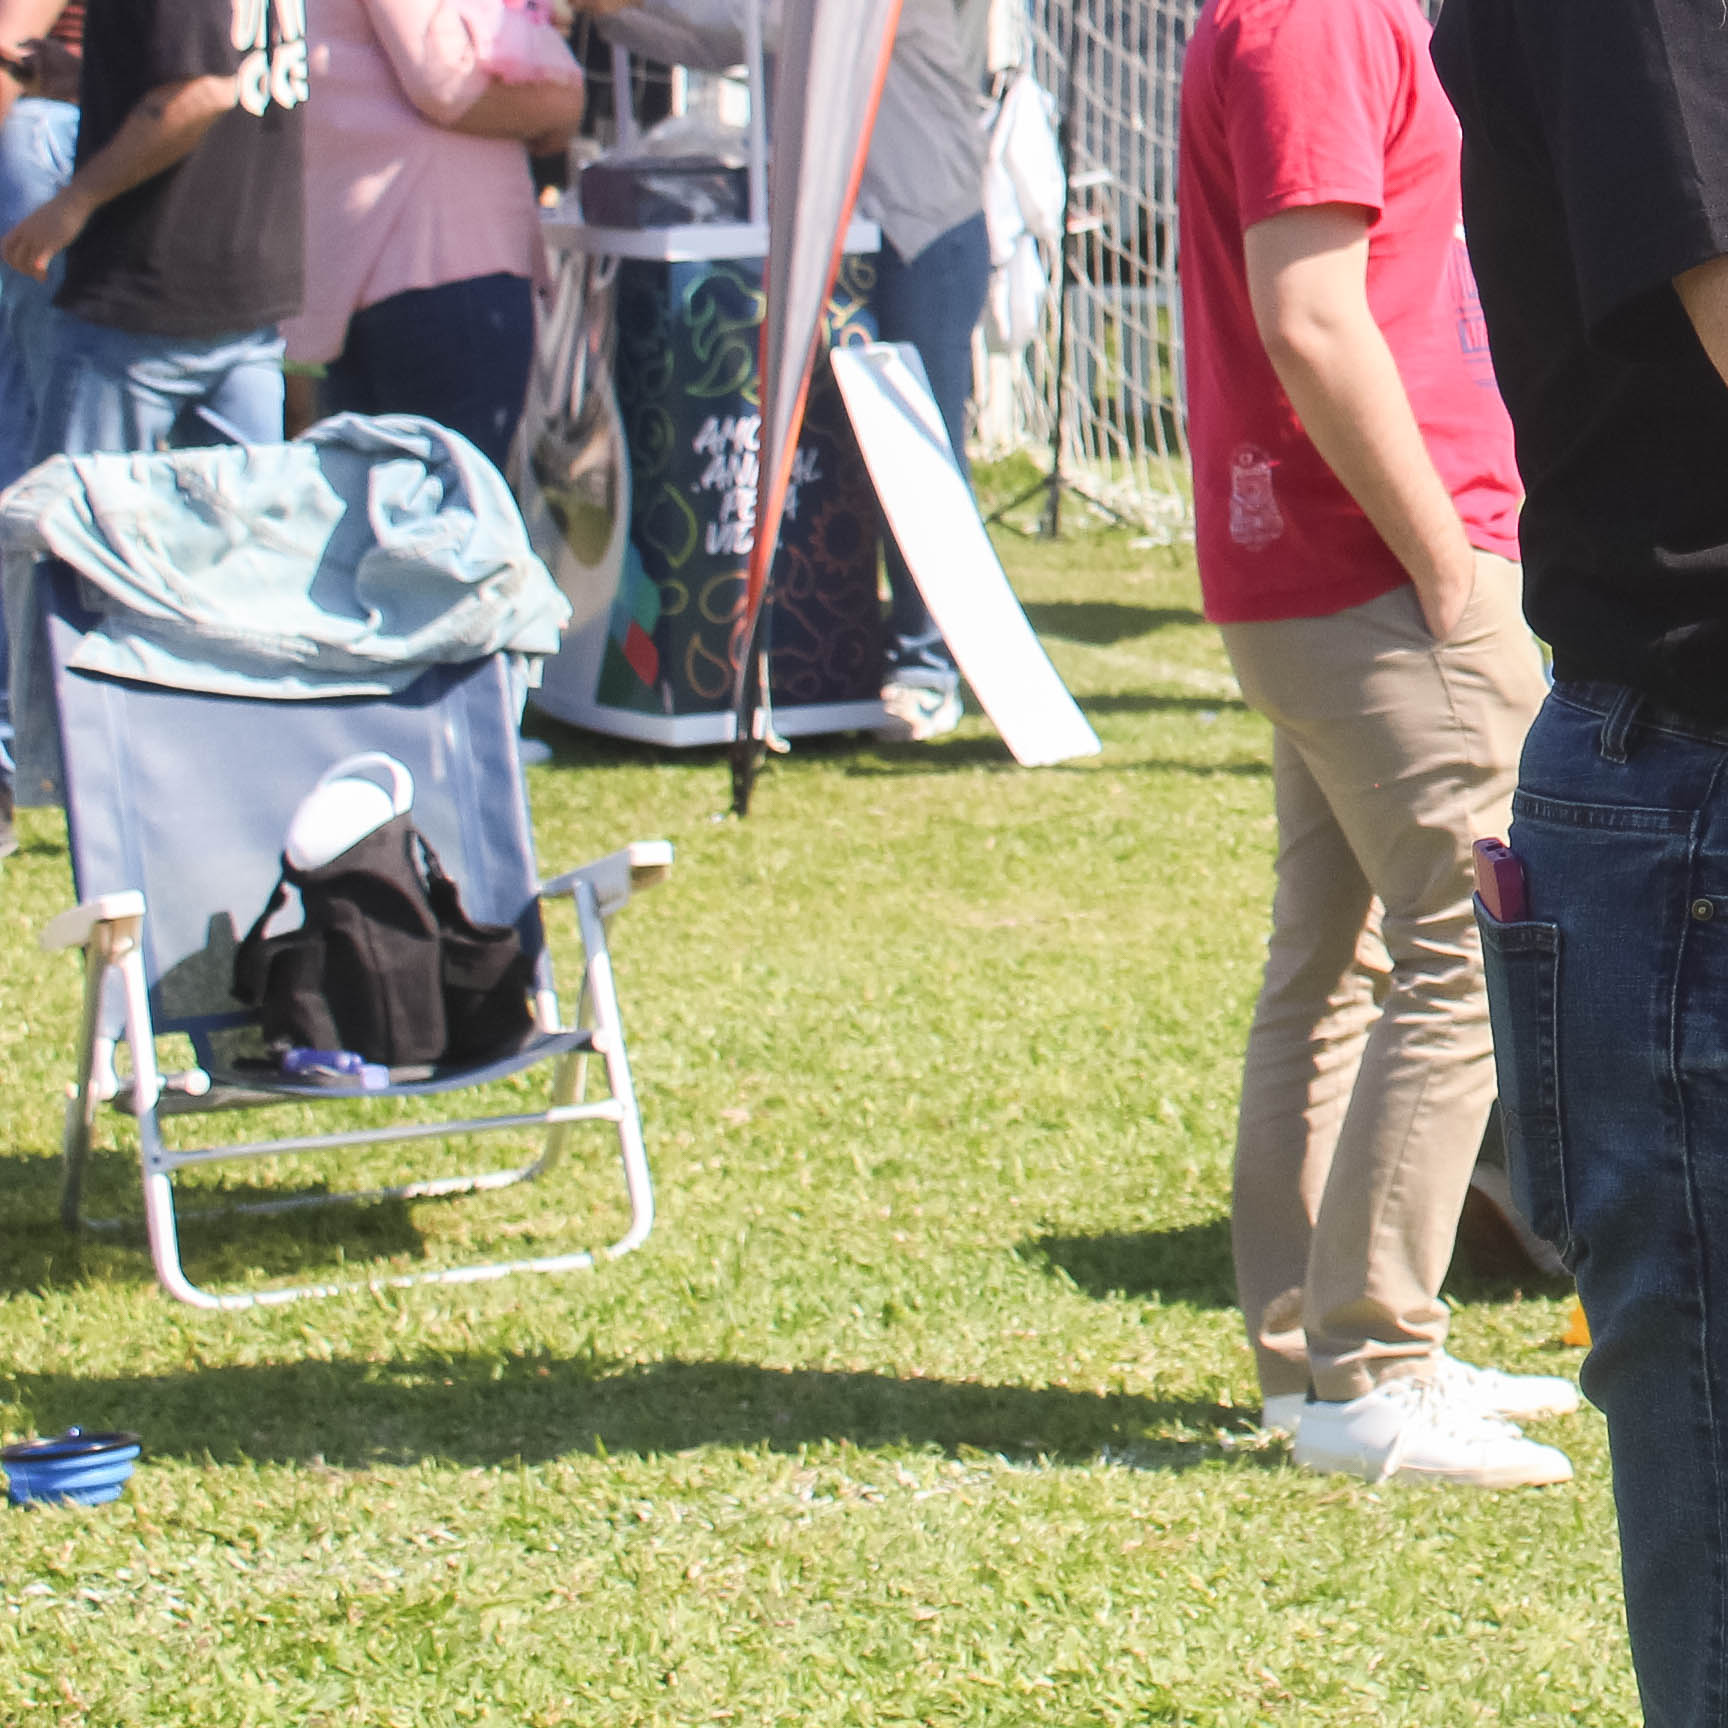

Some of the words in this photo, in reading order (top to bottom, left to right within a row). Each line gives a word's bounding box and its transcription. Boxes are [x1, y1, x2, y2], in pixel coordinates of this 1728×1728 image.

[691, 413, 763, 456] AMO
[700, 446, 824, 491] ANAL
[718, 484, 799, 522] PEA
[705, 521, 784, 556] VID
